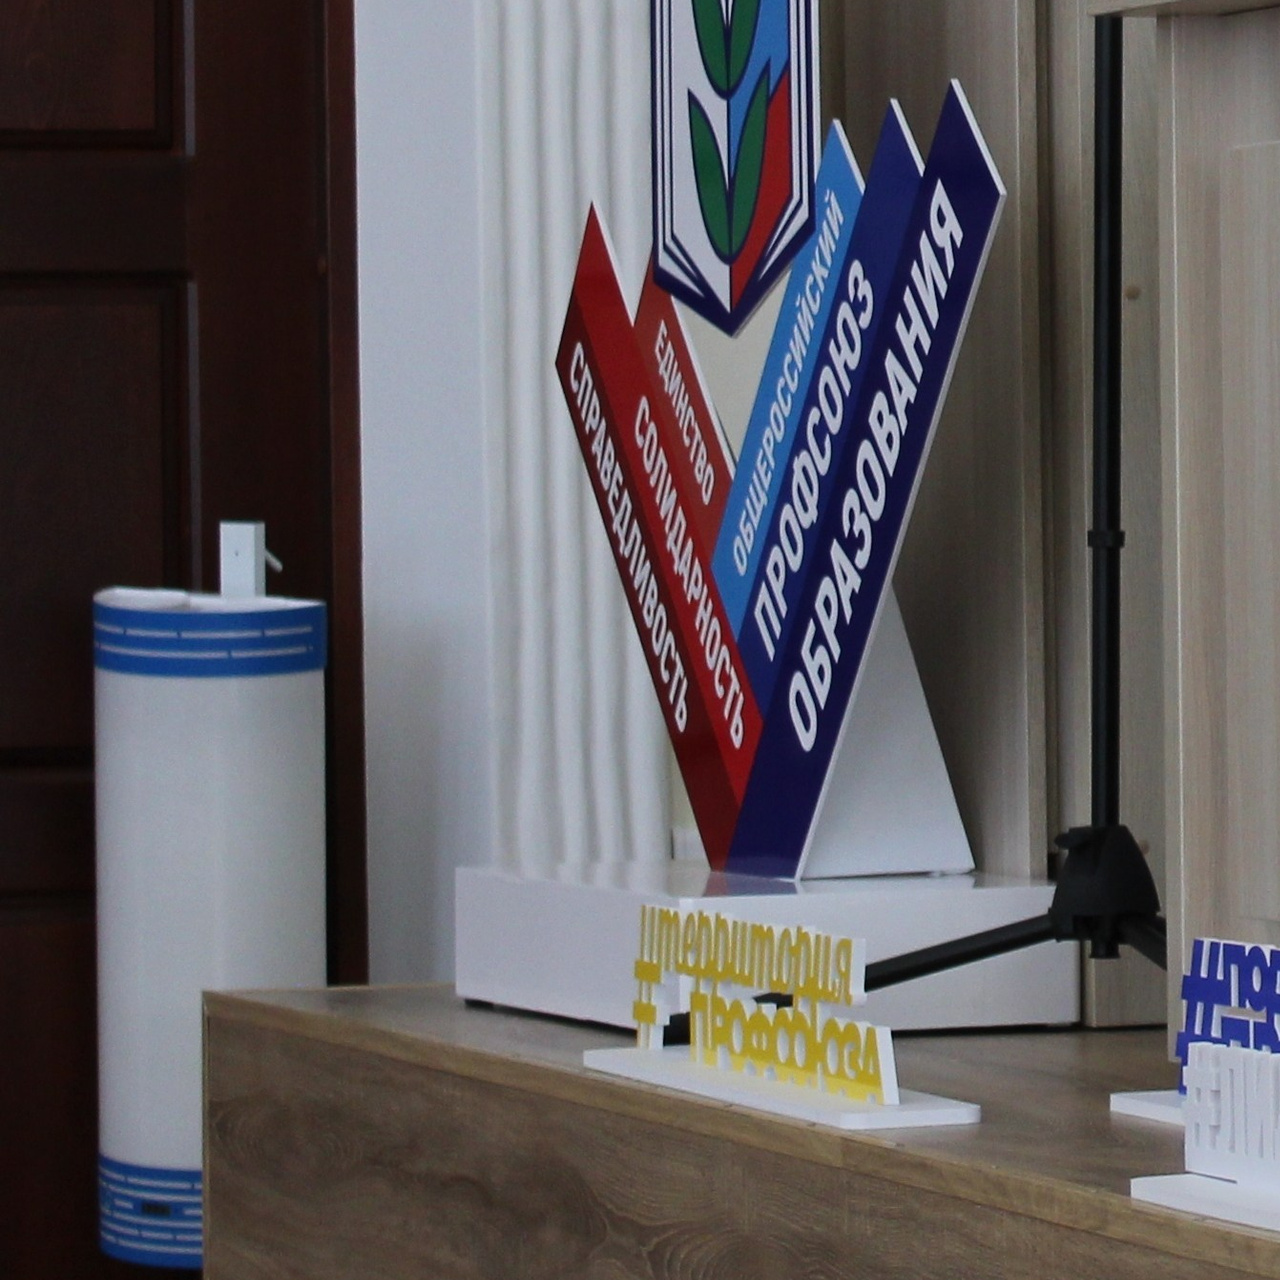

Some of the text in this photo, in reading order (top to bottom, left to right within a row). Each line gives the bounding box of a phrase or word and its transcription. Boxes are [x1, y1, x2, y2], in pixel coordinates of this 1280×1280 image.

[570, 342, 688, 733] СПРАВЕДЛИВОСТЬ
[634, 396, 744, 749] СОЛИДАРНОСТЬ
[654, 319, 716, 506] ЕДИНСТВО
[733, 187, 845, 576] ОБЩЕРОССИЙСКИЙ
[753, 259, 875, 661] ПРОФСОЮЗ
[788, 178, 964, 752] ОБРАЗОВАНИЯ
